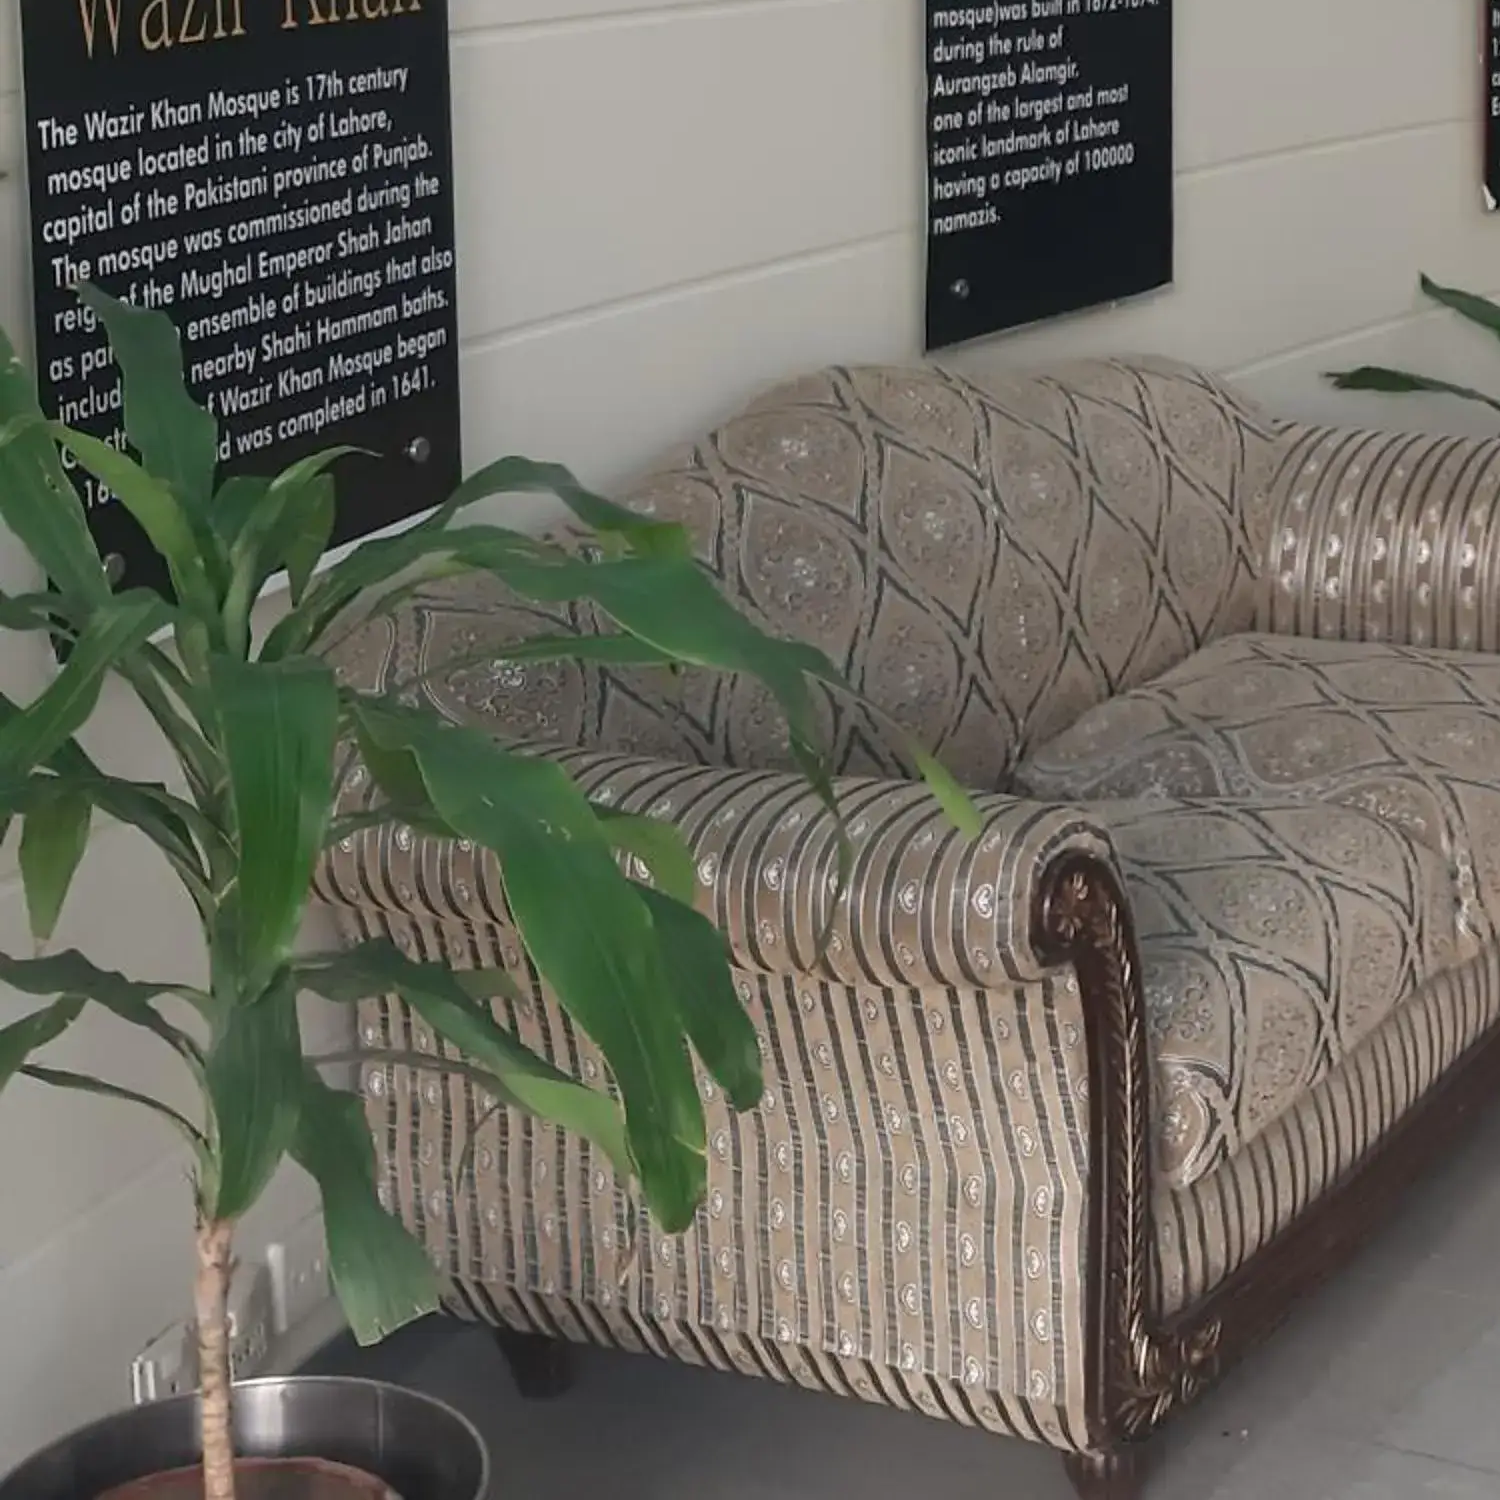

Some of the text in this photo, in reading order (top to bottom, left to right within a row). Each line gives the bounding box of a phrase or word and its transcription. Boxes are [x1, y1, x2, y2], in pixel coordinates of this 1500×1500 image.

[933, 24, 1064, 64] during the rule of
[933, 63, 1016, 97] Aurangzeb
[37, 66, 409, 150] The Wazir Khan Mosque is 17th century
[48, 108, 393, 195] mosque located in the city of Lahore,
[933, 84, 1129, 133] one of the largest and most
[933, 117, 1120, 167] iconic landmark of Lahore
[43, 133, 432, 246] capital of the Pakistani province of Punjab.
[933, 142, 1135, 200] having a capacity of 100000
[52, 172, 439, 288] The mosque was commissioned during the
[933, 202, 1001, 235] namazis.
[50, 355, 73, 381] as
[187, 293, 277, 341] ensemble
[282, 283, 300, 314] of
[305, 269, 382, 308] buildings
[386, 255, 417, 285] that
[421, 246, 453, 275] also
[55, 298, 103, 334] reig
[143, 278, 174, 309] the
[181, 253, 251, 300] Mughal
[258, 241, 333, 279] Emperor
[338, 222, 379, 258] Shah
[384, 214, 432, 246] Jahan
[58, 285, 449, 426] includ nearby Shahi Hammam baths.
[219, 377, 273, 416] Wazir
[278, 366, 323, 398] Khan
[328, 344, 393, 382] Mosque
[397, 327, 447, 360] began
[236, 425, 273, 455] was
[278, 384, 366, 440] completed
[370, 381, 387, 408] in
[392, 365, 436, 399] 1641.
